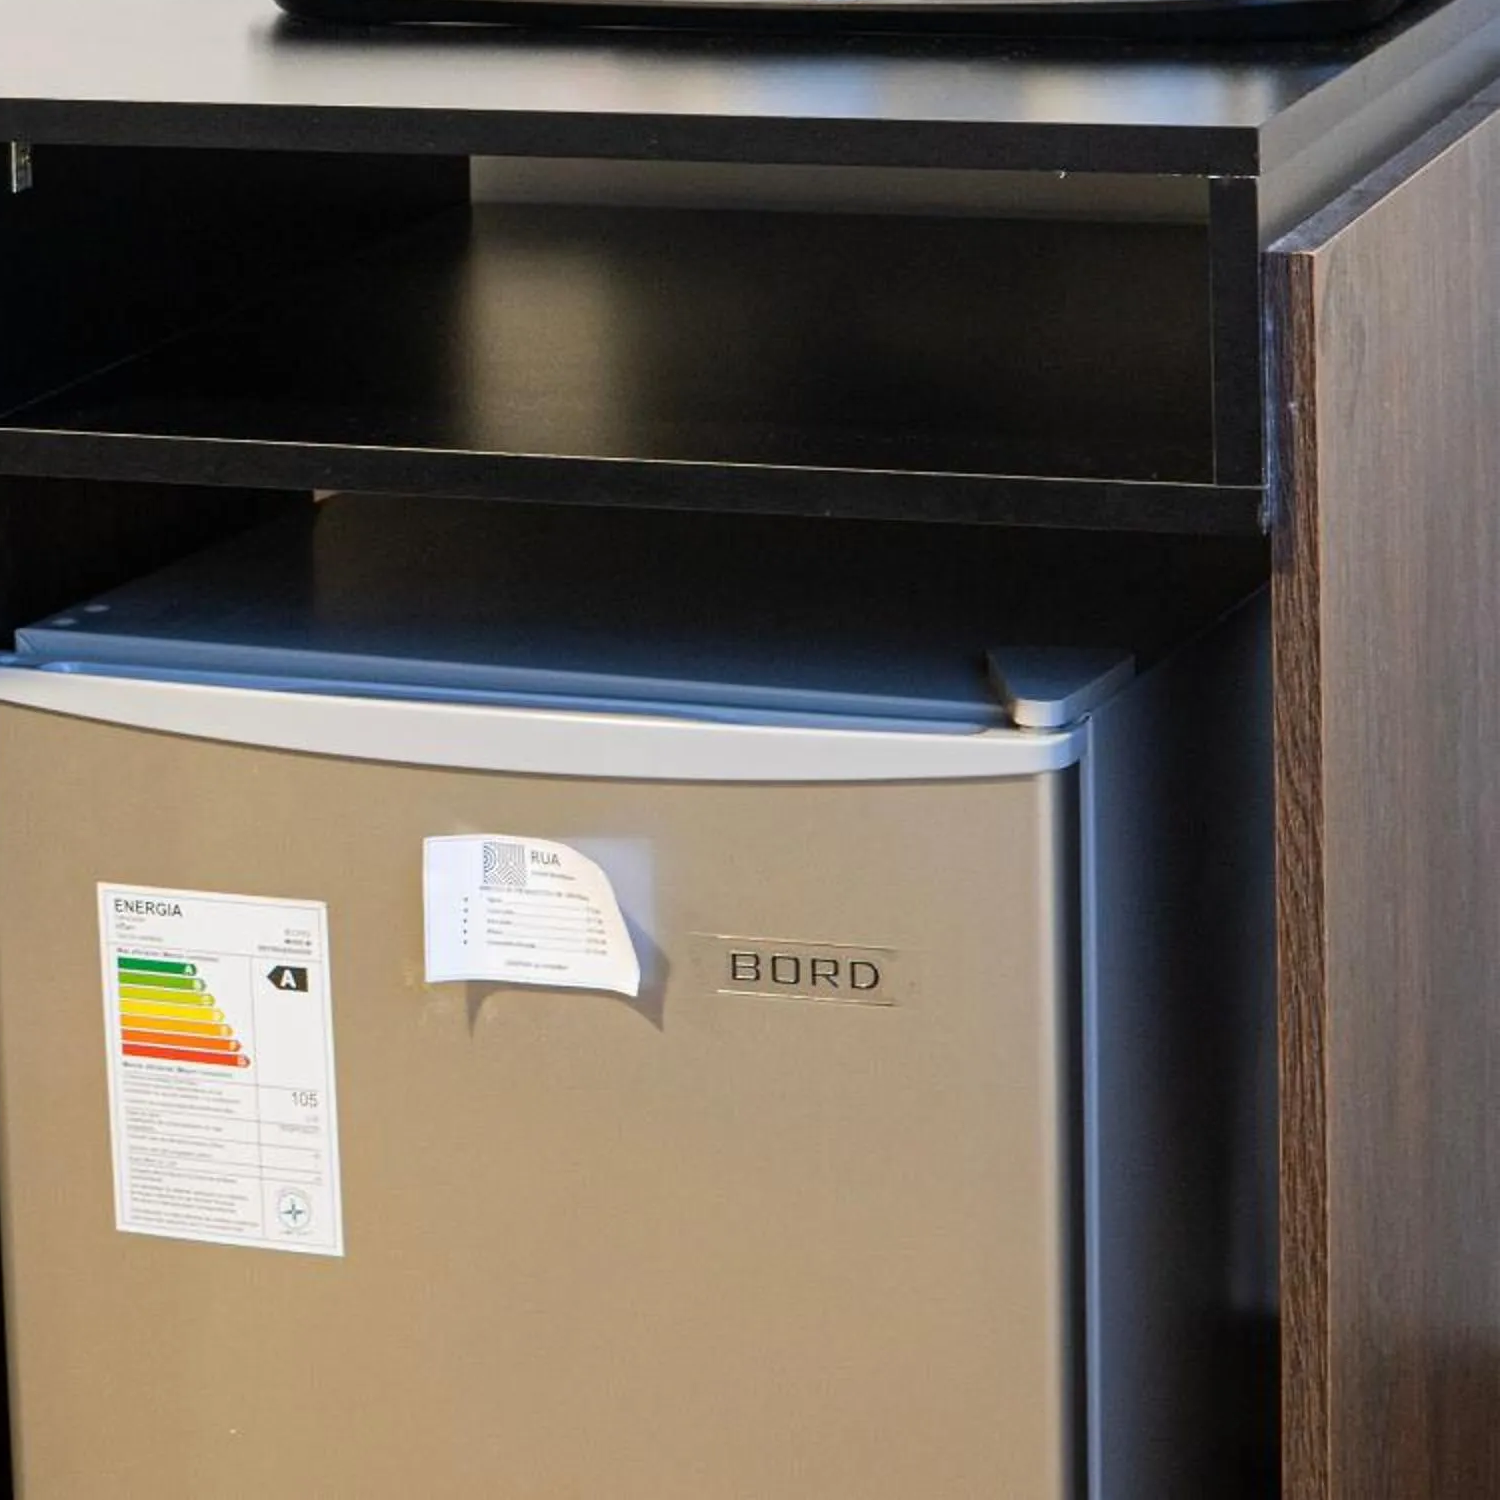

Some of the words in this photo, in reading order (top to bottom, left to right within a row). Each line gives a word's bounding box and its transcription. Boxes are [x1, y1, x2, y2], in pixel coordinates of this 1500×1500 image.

[531, 851, 561, 867] RUA
[114, 898, 183, 917] ENERGIA
[280, 969, 297, 989] A
[731, 953, 879, 990] BORD
[291, 1091, 319, 1108] 105
